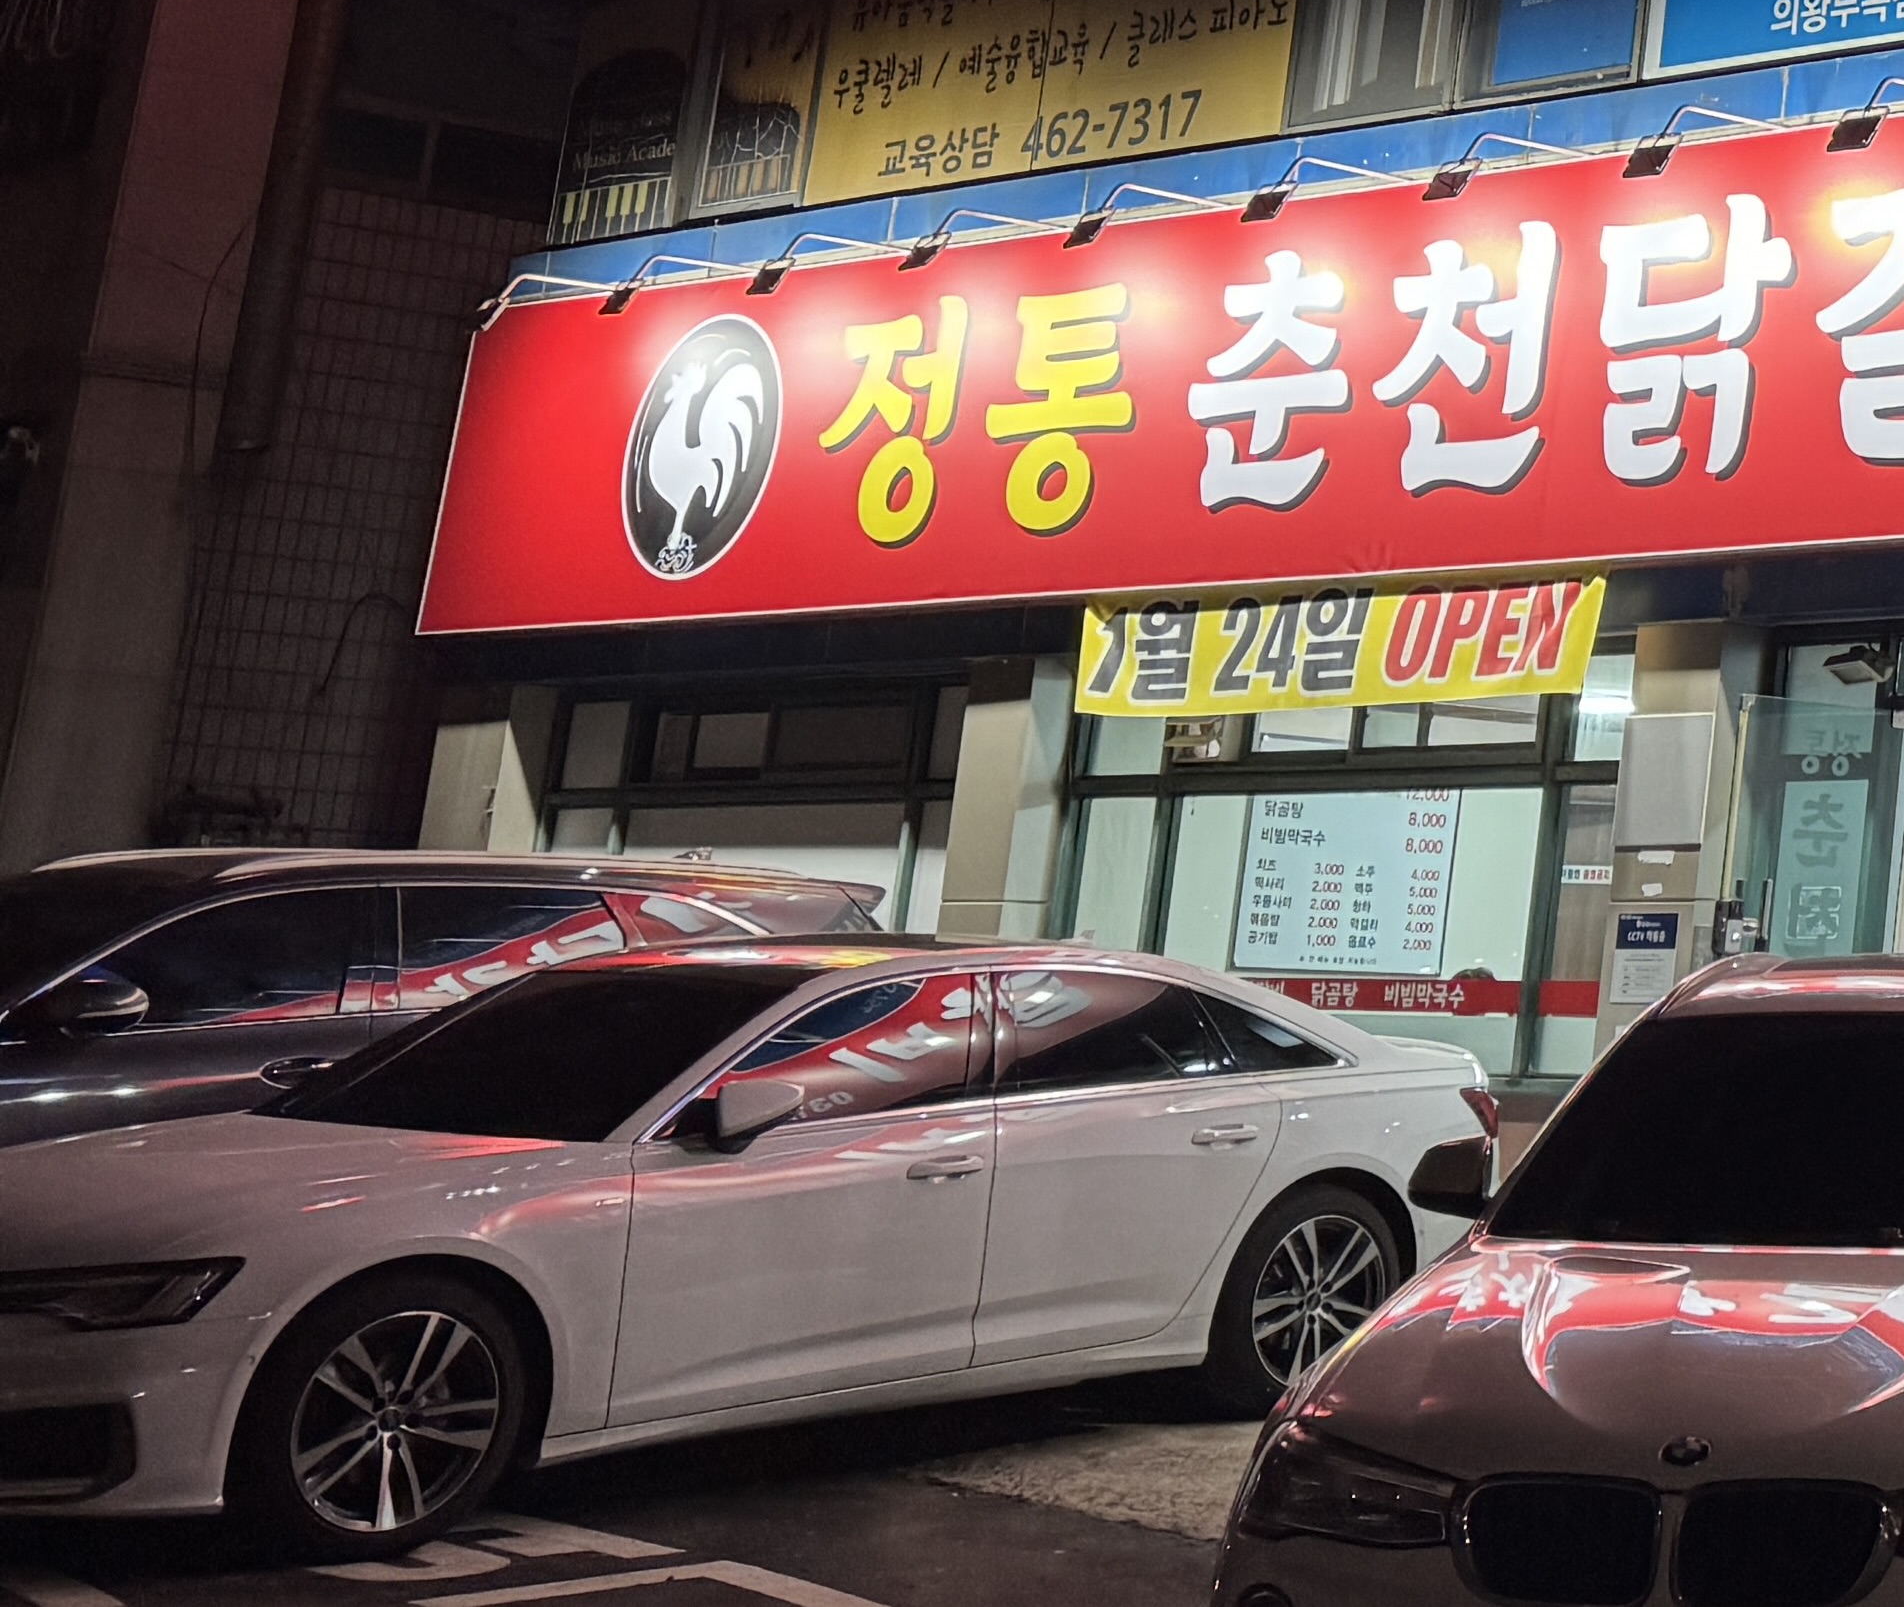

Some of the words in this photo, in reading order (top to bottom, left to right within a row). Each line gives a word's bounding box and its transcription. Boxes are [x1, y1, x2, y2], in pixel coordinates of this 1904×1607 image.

[834, 54, 922, 116] 우쿨렐레
[959, 23, 1090, 93] 예술융합교육
[1127, 10, 1198, 68] 클래스
[877, 122, 1000, 176] 교육상담
[1020, 89, 1203, 162] 462-7317
[819, 283, 1136, 548] 정통
[1213, 586, 1372, 694] 24일
[1385, 578, 1584, 682] OPEN
[1264, 800, 1304, 819] 닭곰탕
[1408, 812, 1446, 828] 8,000
[1260, 827, 1326, 847] 비빔막국수
[1405, 838, 1443, 854] 8,000
[1314, 862, 1345, 876] 3,000
[1355, 865, 1375, 878] 소주
[1411, 868, 1440, 882] 4,000
[1311, 880, 1342, 894] 2,000
[1409, 886, 1438, 899] 5,000
[1309, 898, 1340, 912] 2,000
[1407, 904, 1436, 917] 5,000
[1307, 916, 1338, 929] 2,000
[1405, 922, 1434, 935] 4,000
[1306, 934, 1336, 948] 1,000
[1402, 939, 1432, 951] 2,000
[1311, 981, 1358, 1006] 닭곰탕
[1384, 982, 1464, 1008] 비빔막국수
